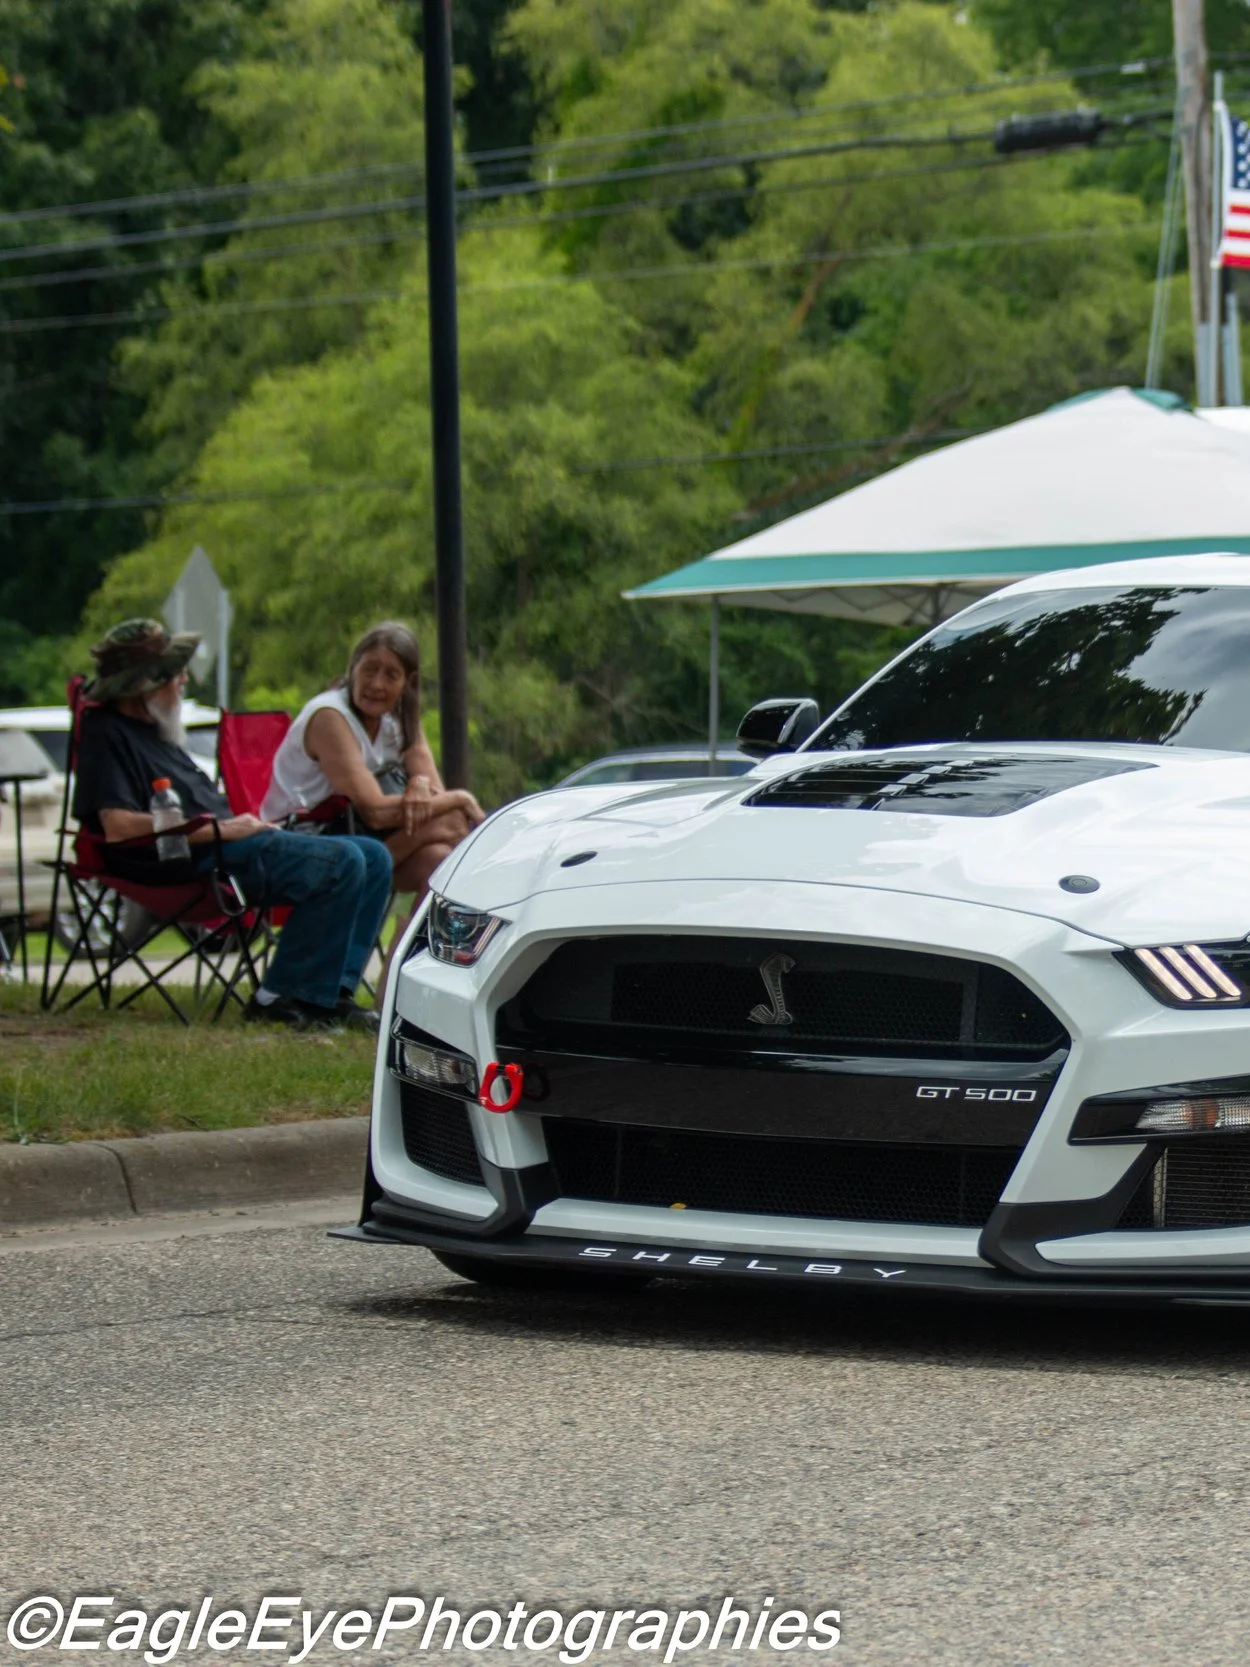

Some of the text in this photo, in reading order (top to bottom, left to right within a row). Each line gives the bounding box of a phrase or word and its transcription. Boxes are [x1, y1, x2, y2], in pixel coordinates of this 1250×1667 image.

[916, 1086, 1037, 1102] GT 500
[579, 1246, 906, 1278] SHELBY
